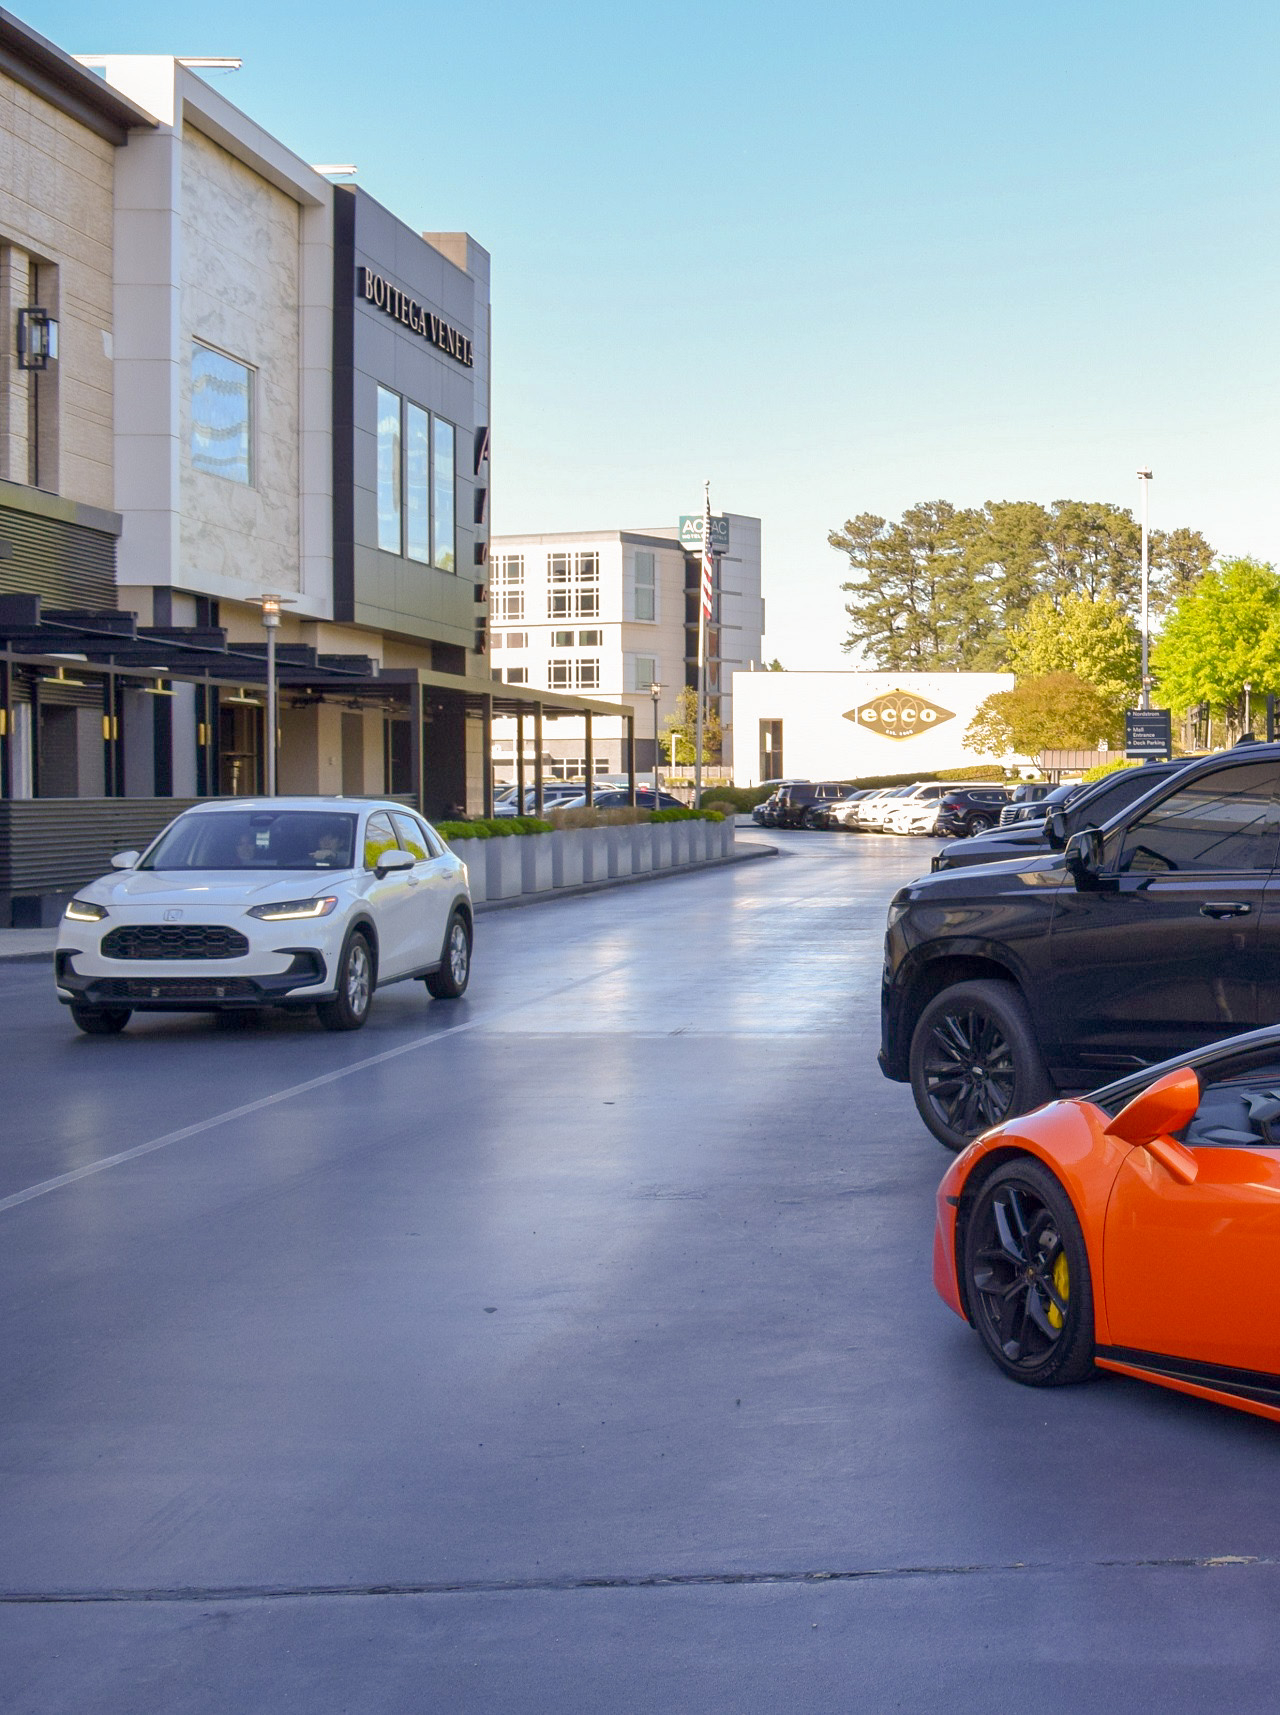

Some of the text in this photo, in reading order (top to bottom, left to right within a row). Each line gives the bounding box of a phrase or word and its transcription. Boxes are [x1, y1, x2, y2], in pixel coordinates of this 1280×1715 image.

[365, 266, 474, 368] BOTTEGA VENETA
[861, 708, 937, 722] ecco
